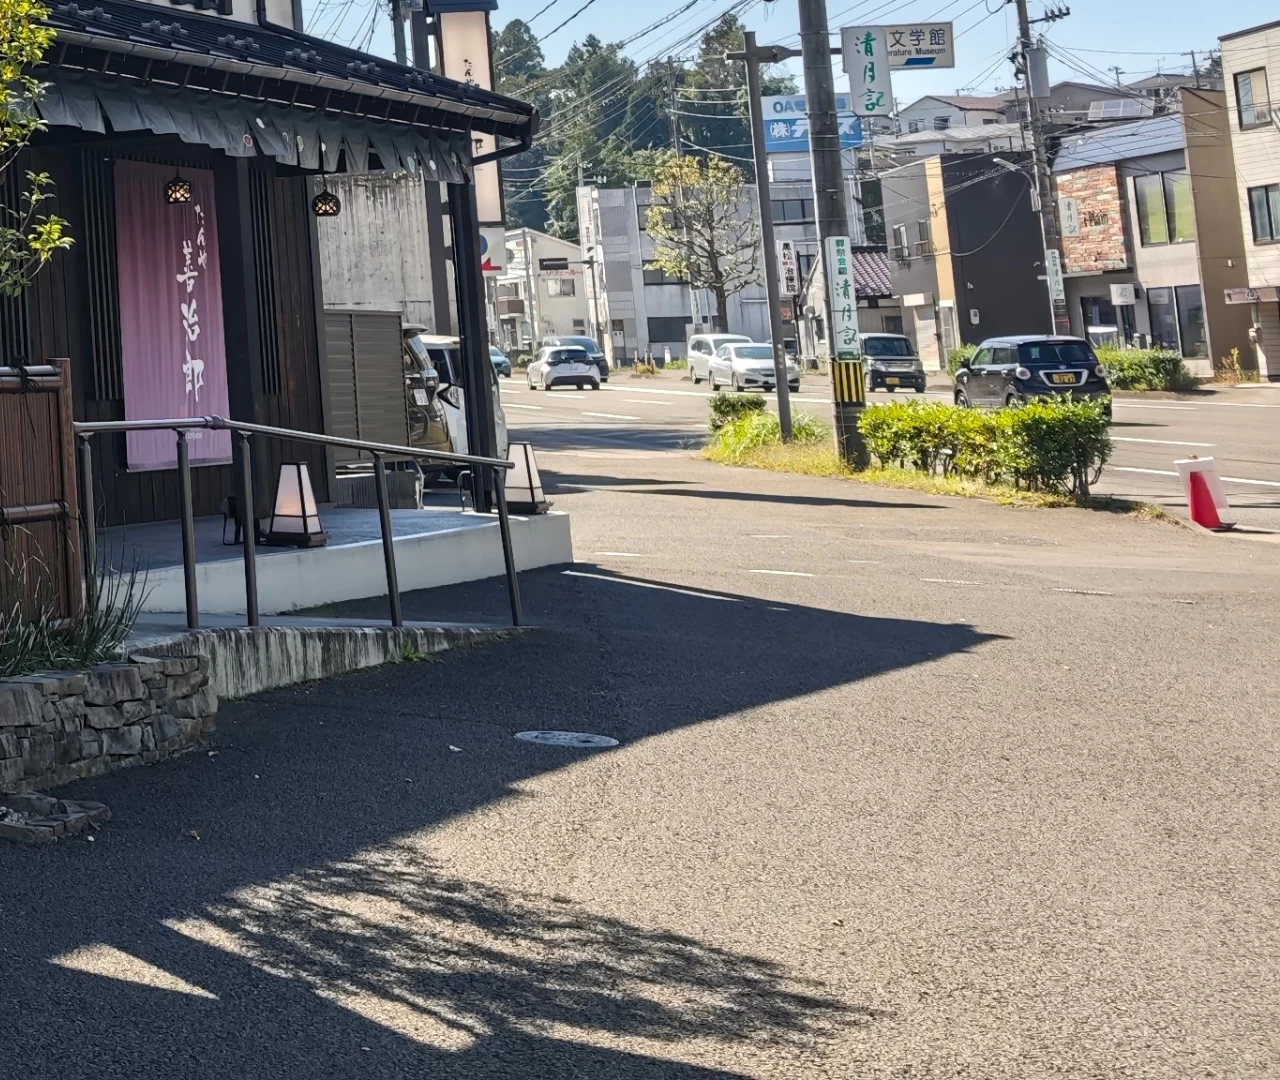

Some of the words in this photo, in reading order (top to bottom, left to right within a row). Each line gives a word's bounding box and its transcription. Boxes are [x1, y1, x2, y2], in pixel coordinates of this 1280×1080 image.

[854, 31, 887, 112] 清月記
[888, 28, 946, 48] 文学館
[915, 47, 946, 56] Museum
[176, 239, 205, 403] 善治郎
[835, 278, 858, 345] 清月記
